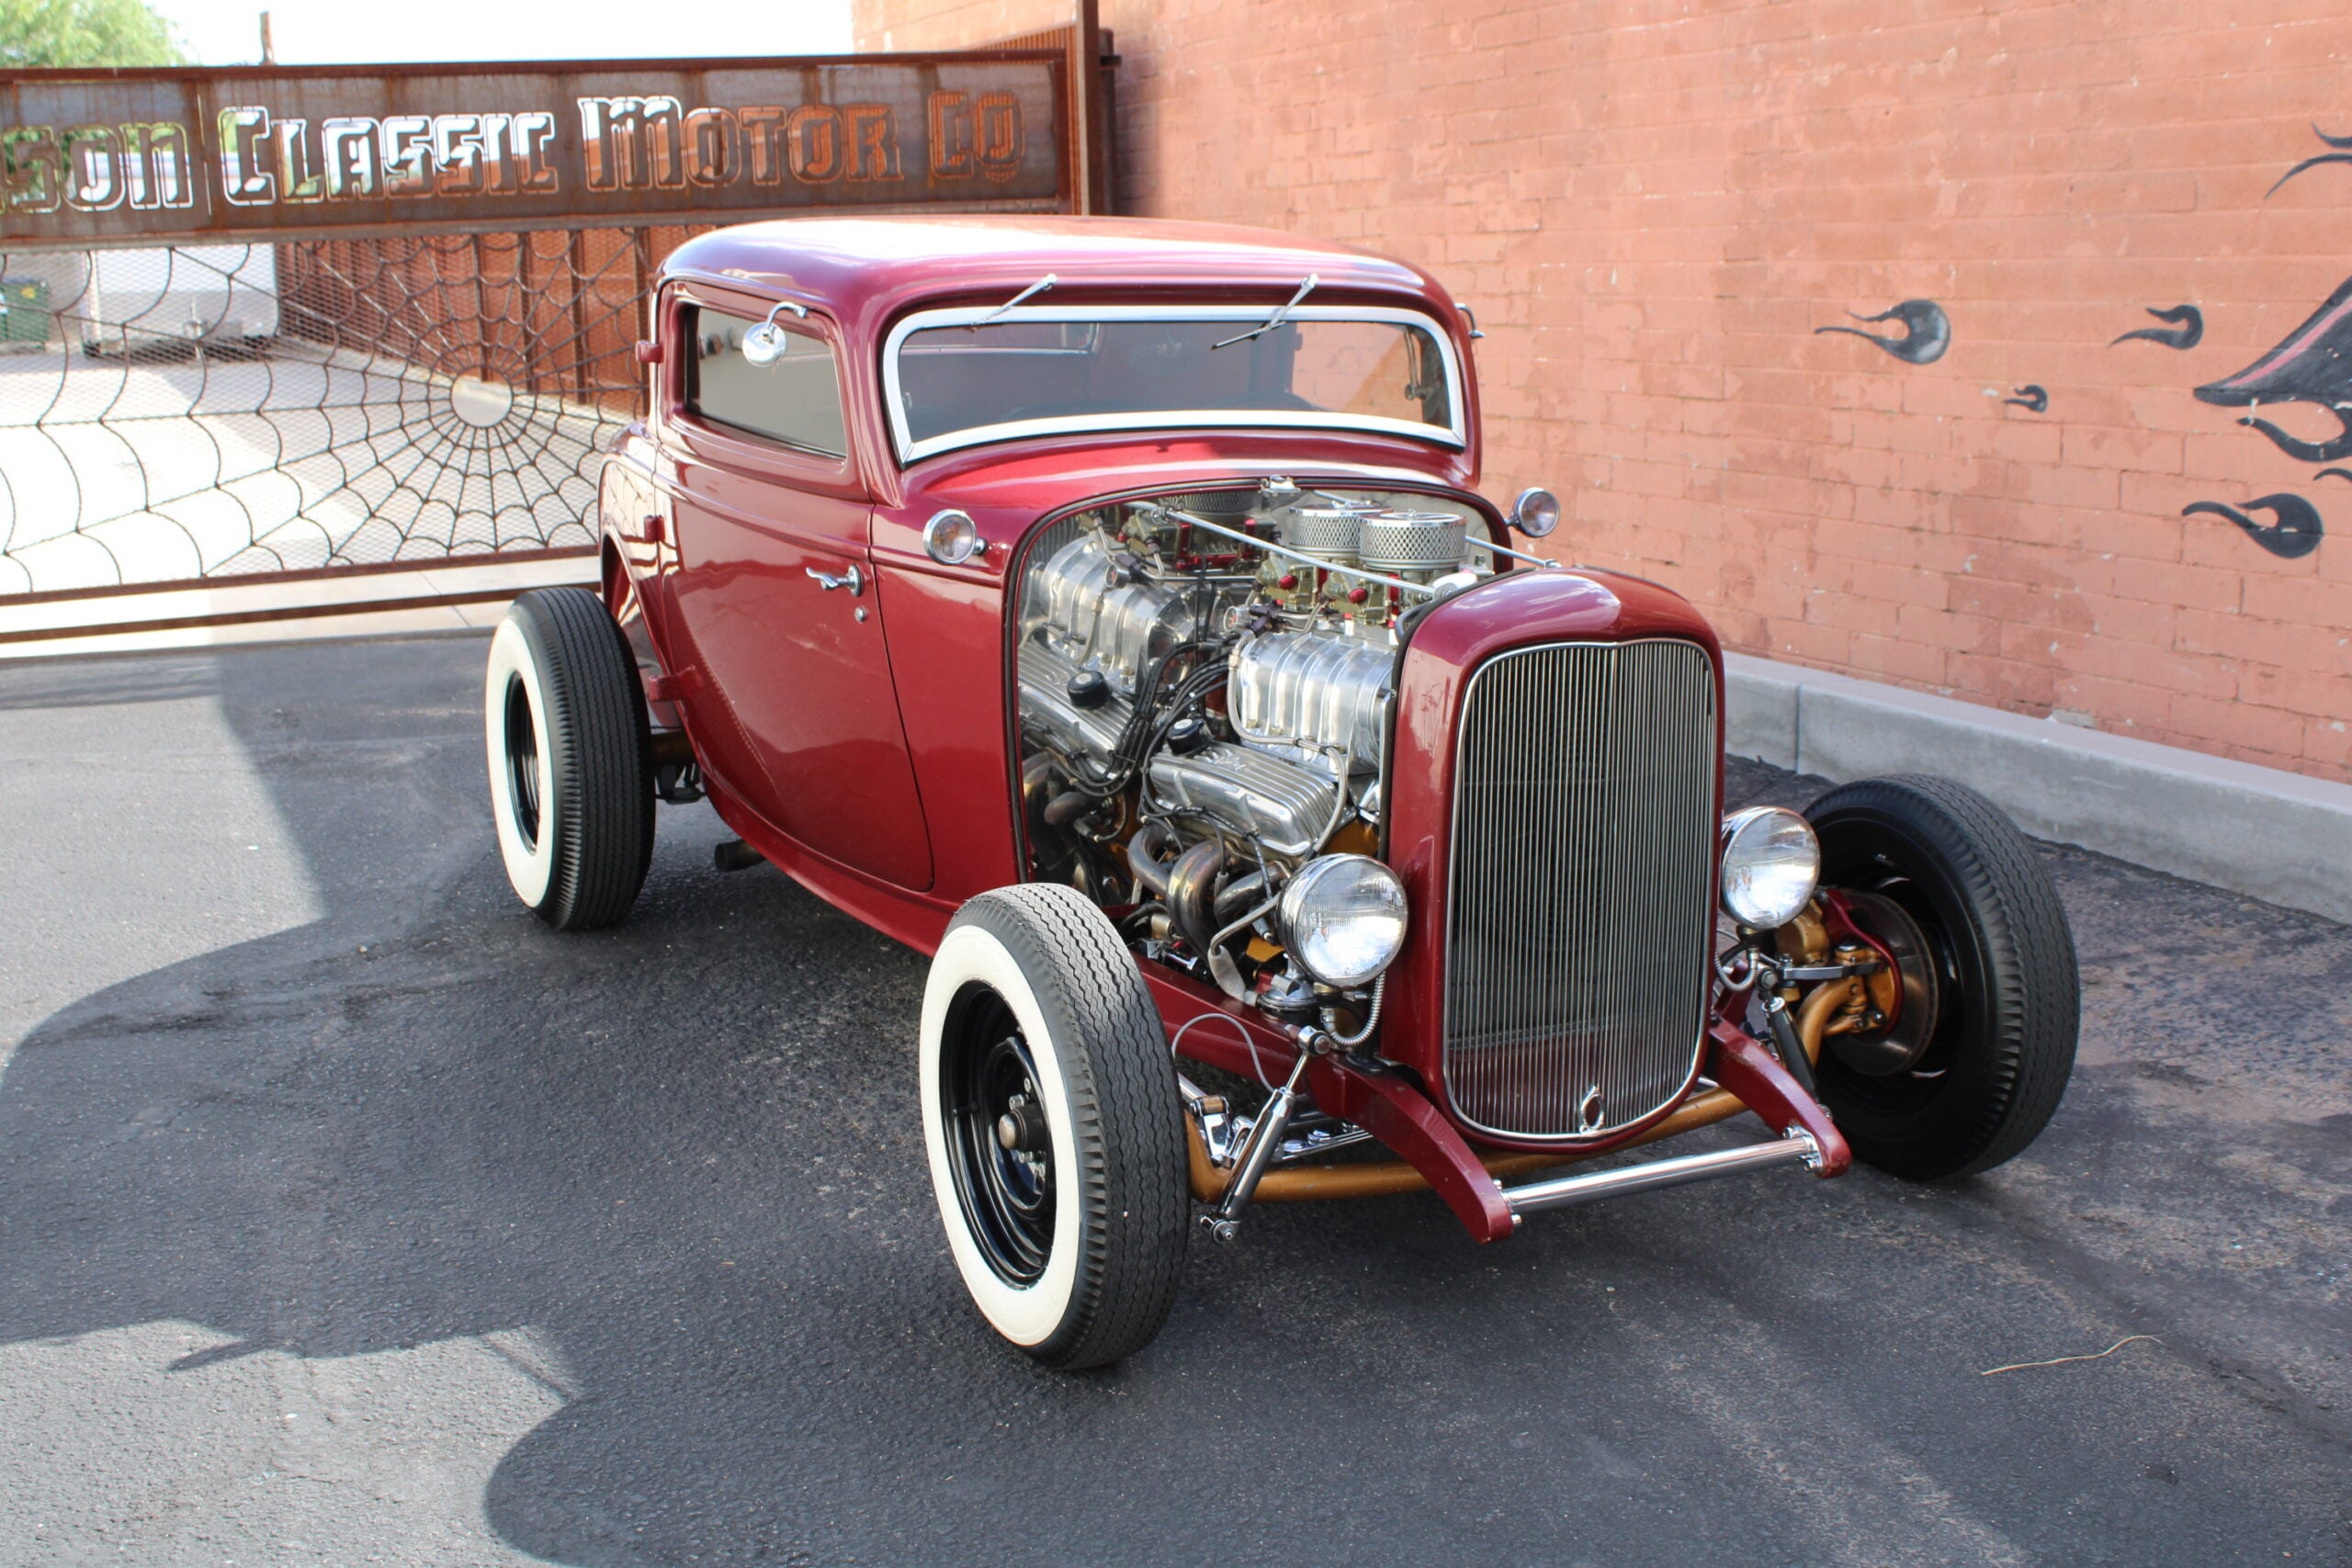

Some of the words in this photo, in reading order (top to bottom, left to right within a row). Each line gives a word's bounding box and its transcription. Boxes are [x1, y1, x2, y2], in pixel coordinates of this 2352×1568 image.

[218, 106, 559, 207] CLASSIC
[577, 95, 905, 193] MOTOR
[928, 89, 1026, 180] CO
